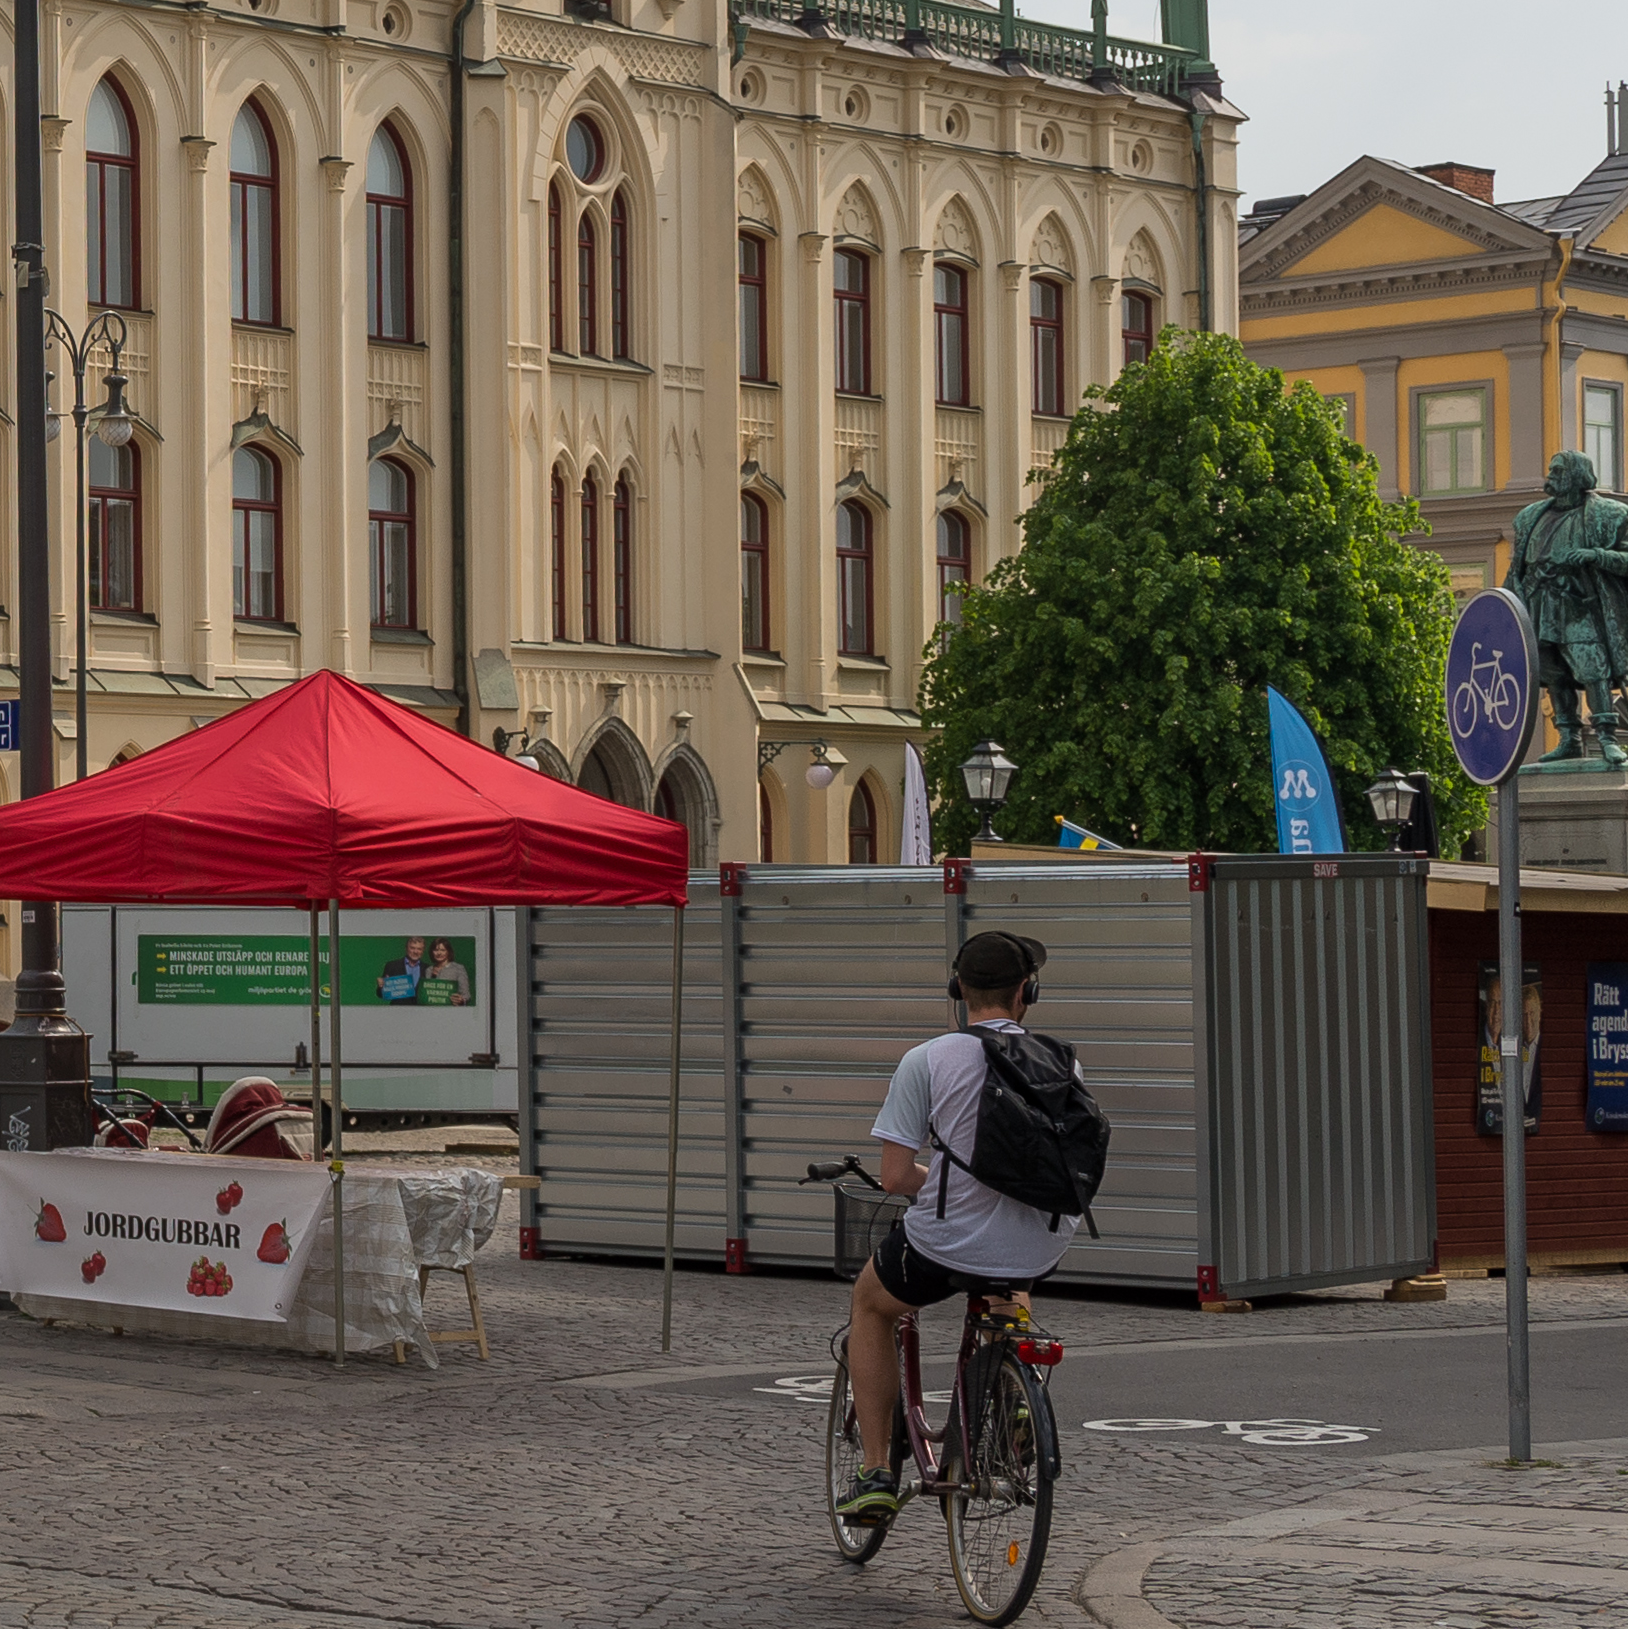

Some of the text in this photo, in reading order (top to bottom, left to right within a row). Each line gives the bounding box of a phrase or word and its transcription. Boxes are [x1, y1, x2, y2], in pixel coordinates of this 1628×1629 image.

[1313, 863, 1338, 877] SAVE
[169, 951, 214, 962] MINSKADE
[216, 949, 254, 962] UTSLÄPP
[255, 951, 273, 962] OCH
[275, 952, 309, 962] RENARE
[169, 963, 308, 976] ETT ÖPPET OCH HUMANT EUROPA
[248, 986, 312, 996] miljöpartiet de grö
[1594, 982, 1620, 1006] Rätt
[1592, 1008, 1628, 1036] agend
[1592, 1038, 1597, 1060] i
[83, 1211, 241, 1249] JORDGUBBAR
